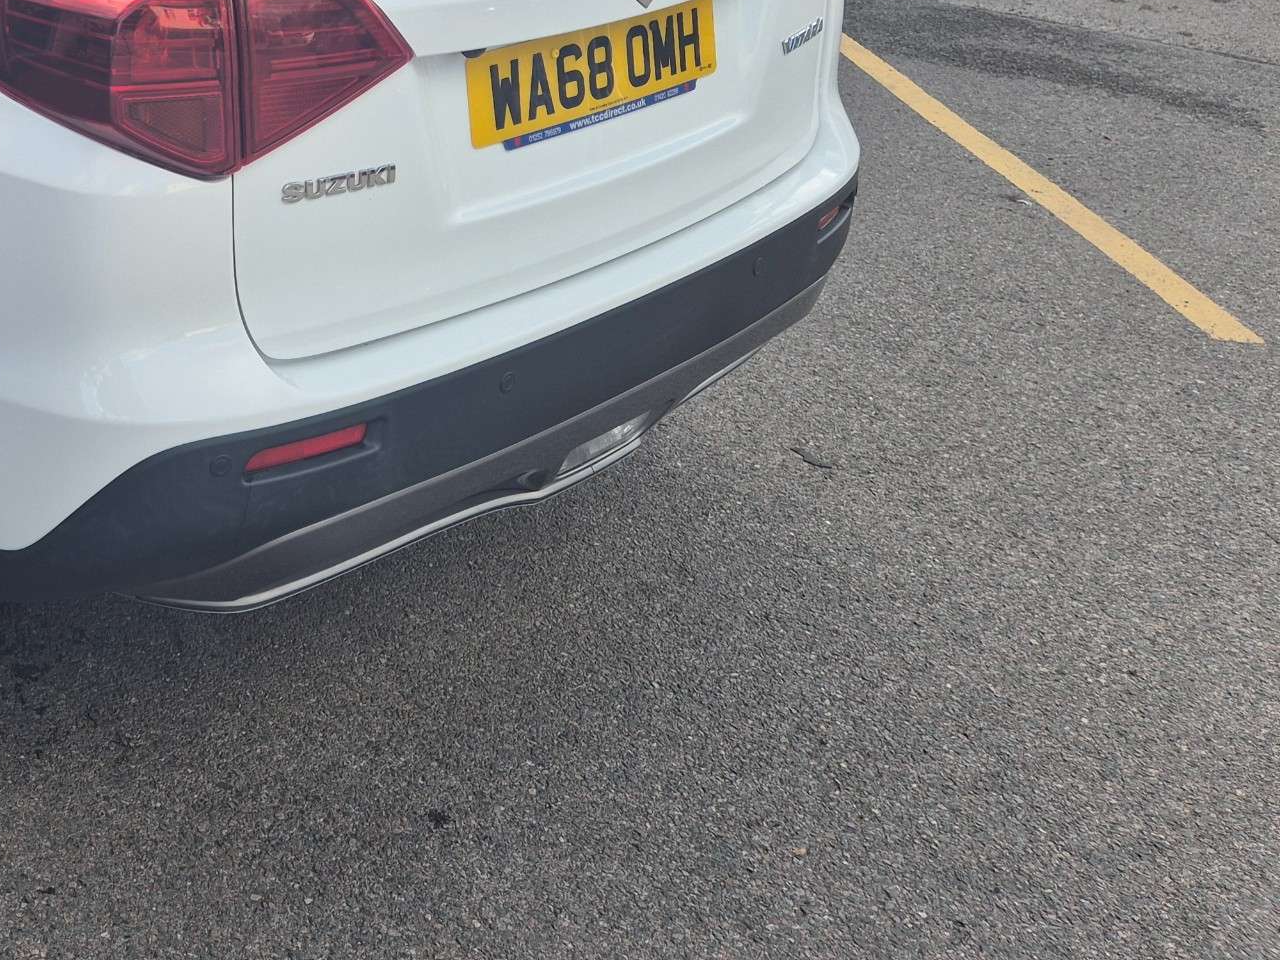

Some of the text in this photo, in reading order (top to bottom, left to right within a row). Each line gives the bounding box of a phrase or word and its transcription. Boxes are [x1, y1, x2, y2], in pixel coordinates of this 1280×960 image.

[781, 16, 825, 56] VITARA
[489, 7, 702, 131] WA68 OMH
[569, 97, 647, 131] www.tccdirect.co.uk
[281, 164, 396, 203] SUZUKI
